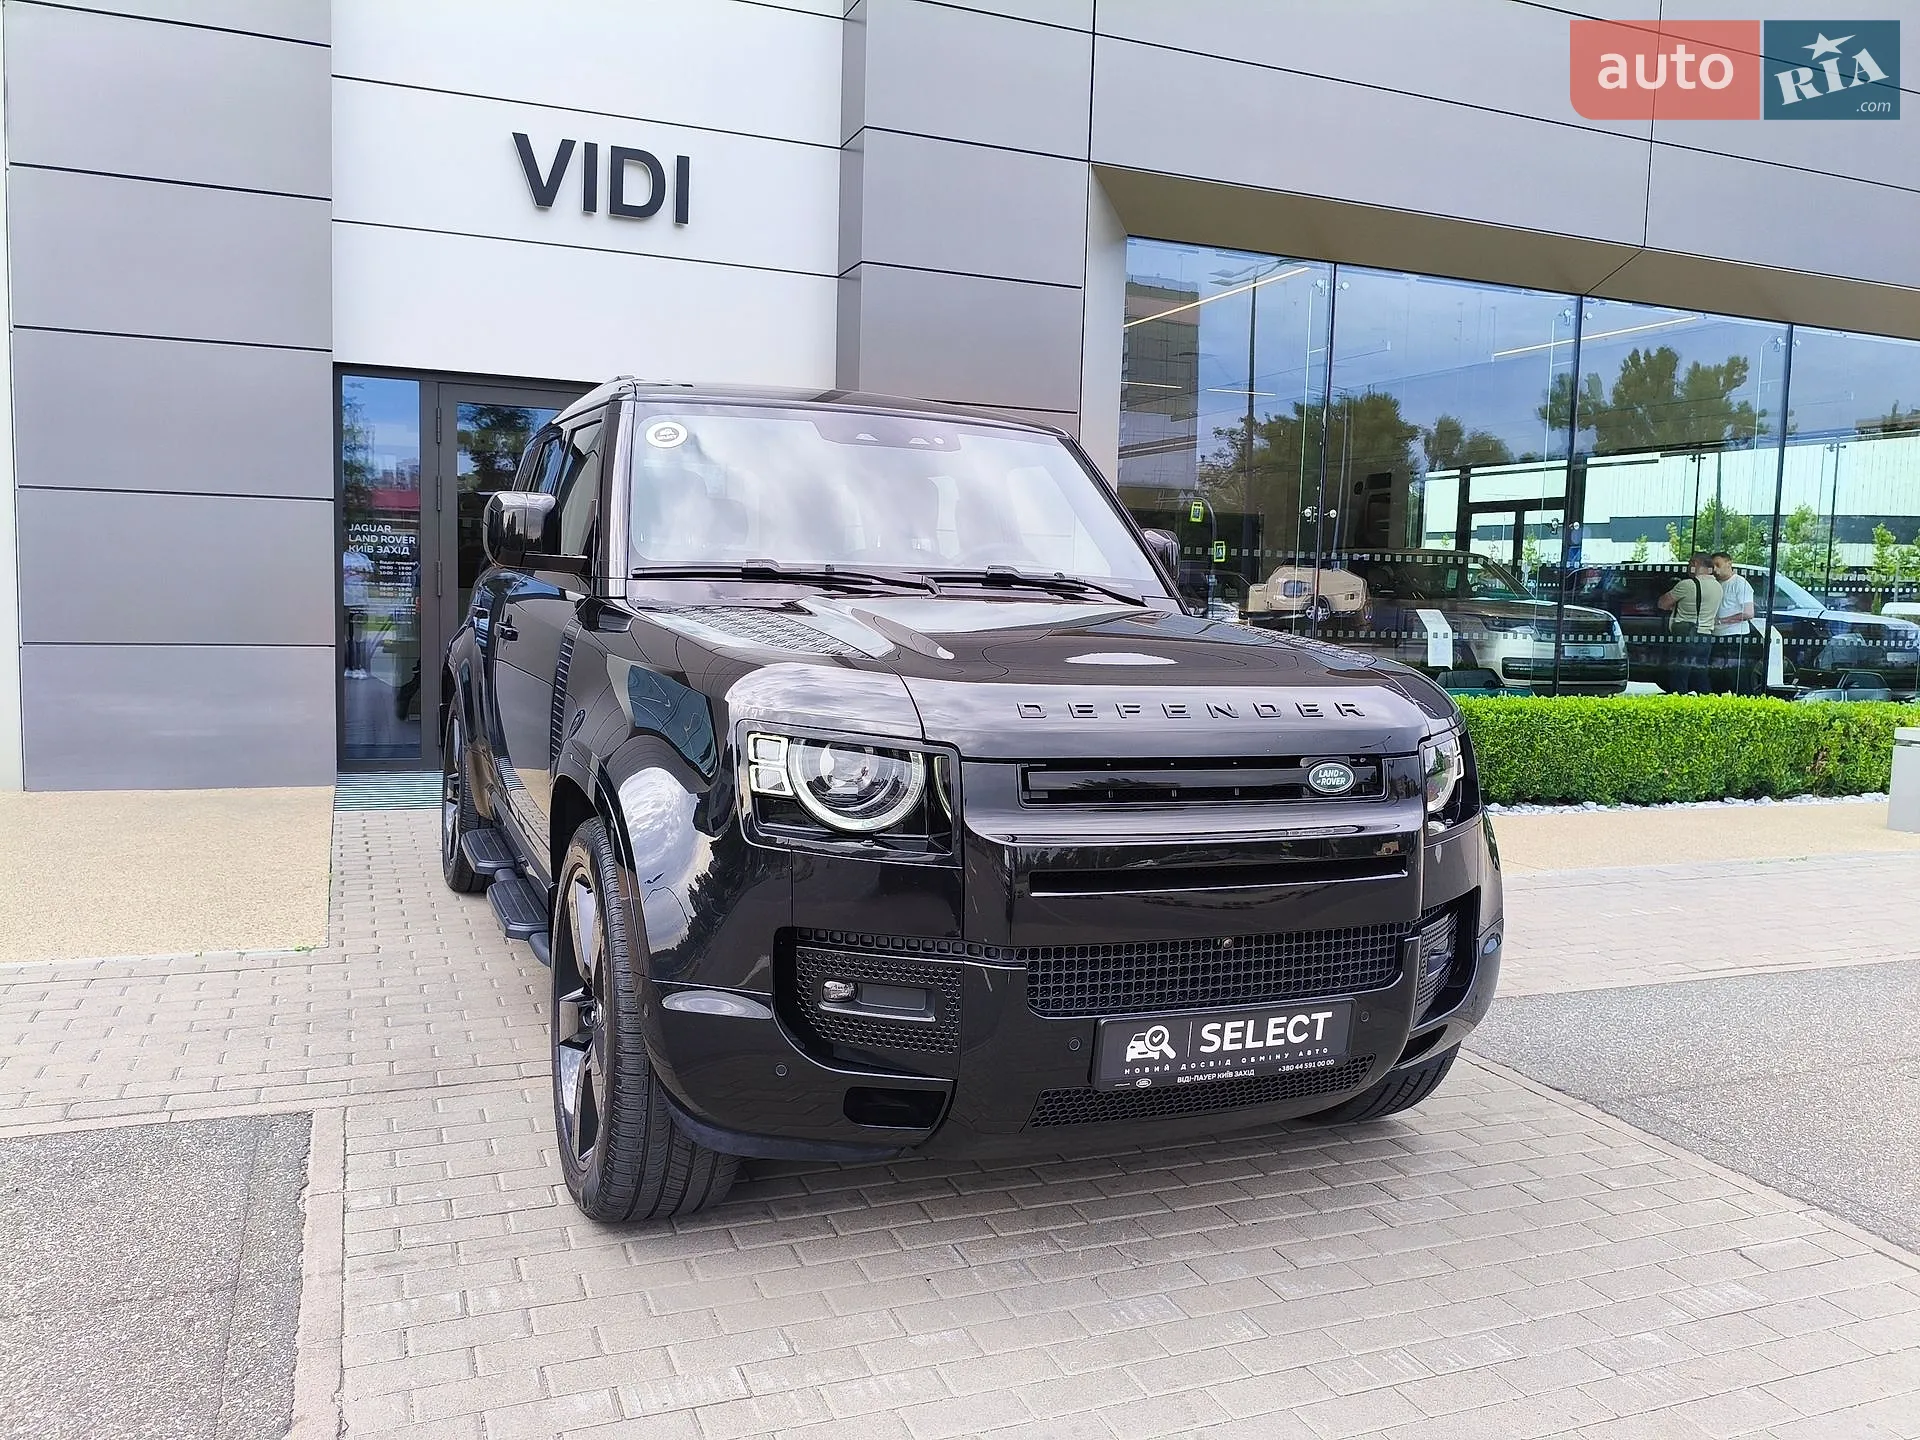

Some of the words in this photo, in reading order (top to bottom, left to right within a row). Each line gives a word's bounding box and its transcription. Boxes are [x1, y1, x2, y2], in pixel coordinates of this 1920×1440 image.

[511, 131, 690, 225] VIDI
[349, 523, 392, 533] JAGUAR
[349, 534, 378, 544] LAND
[380, 536, 416, 545] ROVER
[349, 543, 374, 554] КИЇВ
[376, 545, 410, 555] ЗАХІД
[1016, 701, 1366, 719] DEFENDER
[1318, 769, 1339, 778] LAND
[1320, 777, 1346, 786] ROVER
[1199, 1011, 1333, 1053] SELECT
[1124, 1063, 1170, 1075] НОВИЙ
[1180, 1059, 1231, 1071] ДОСВІД
[1241, 1052, 1290, 1064] ОБМІНУ
[1298, 1047, 1328, 1057] АВТО
[1278, 1064, 1294, 1072] +380
[1294, 1062, 1304, 1070] 44
[1304, 1061, 1316, 1069] 591
[1177, 1073, 1217, 1084] ВІДІ-ПАУЕР
[1217, 1070, 1233, 1079] КИЇВ
[1234, 1069, 1255, 1078] ЗАХІД
